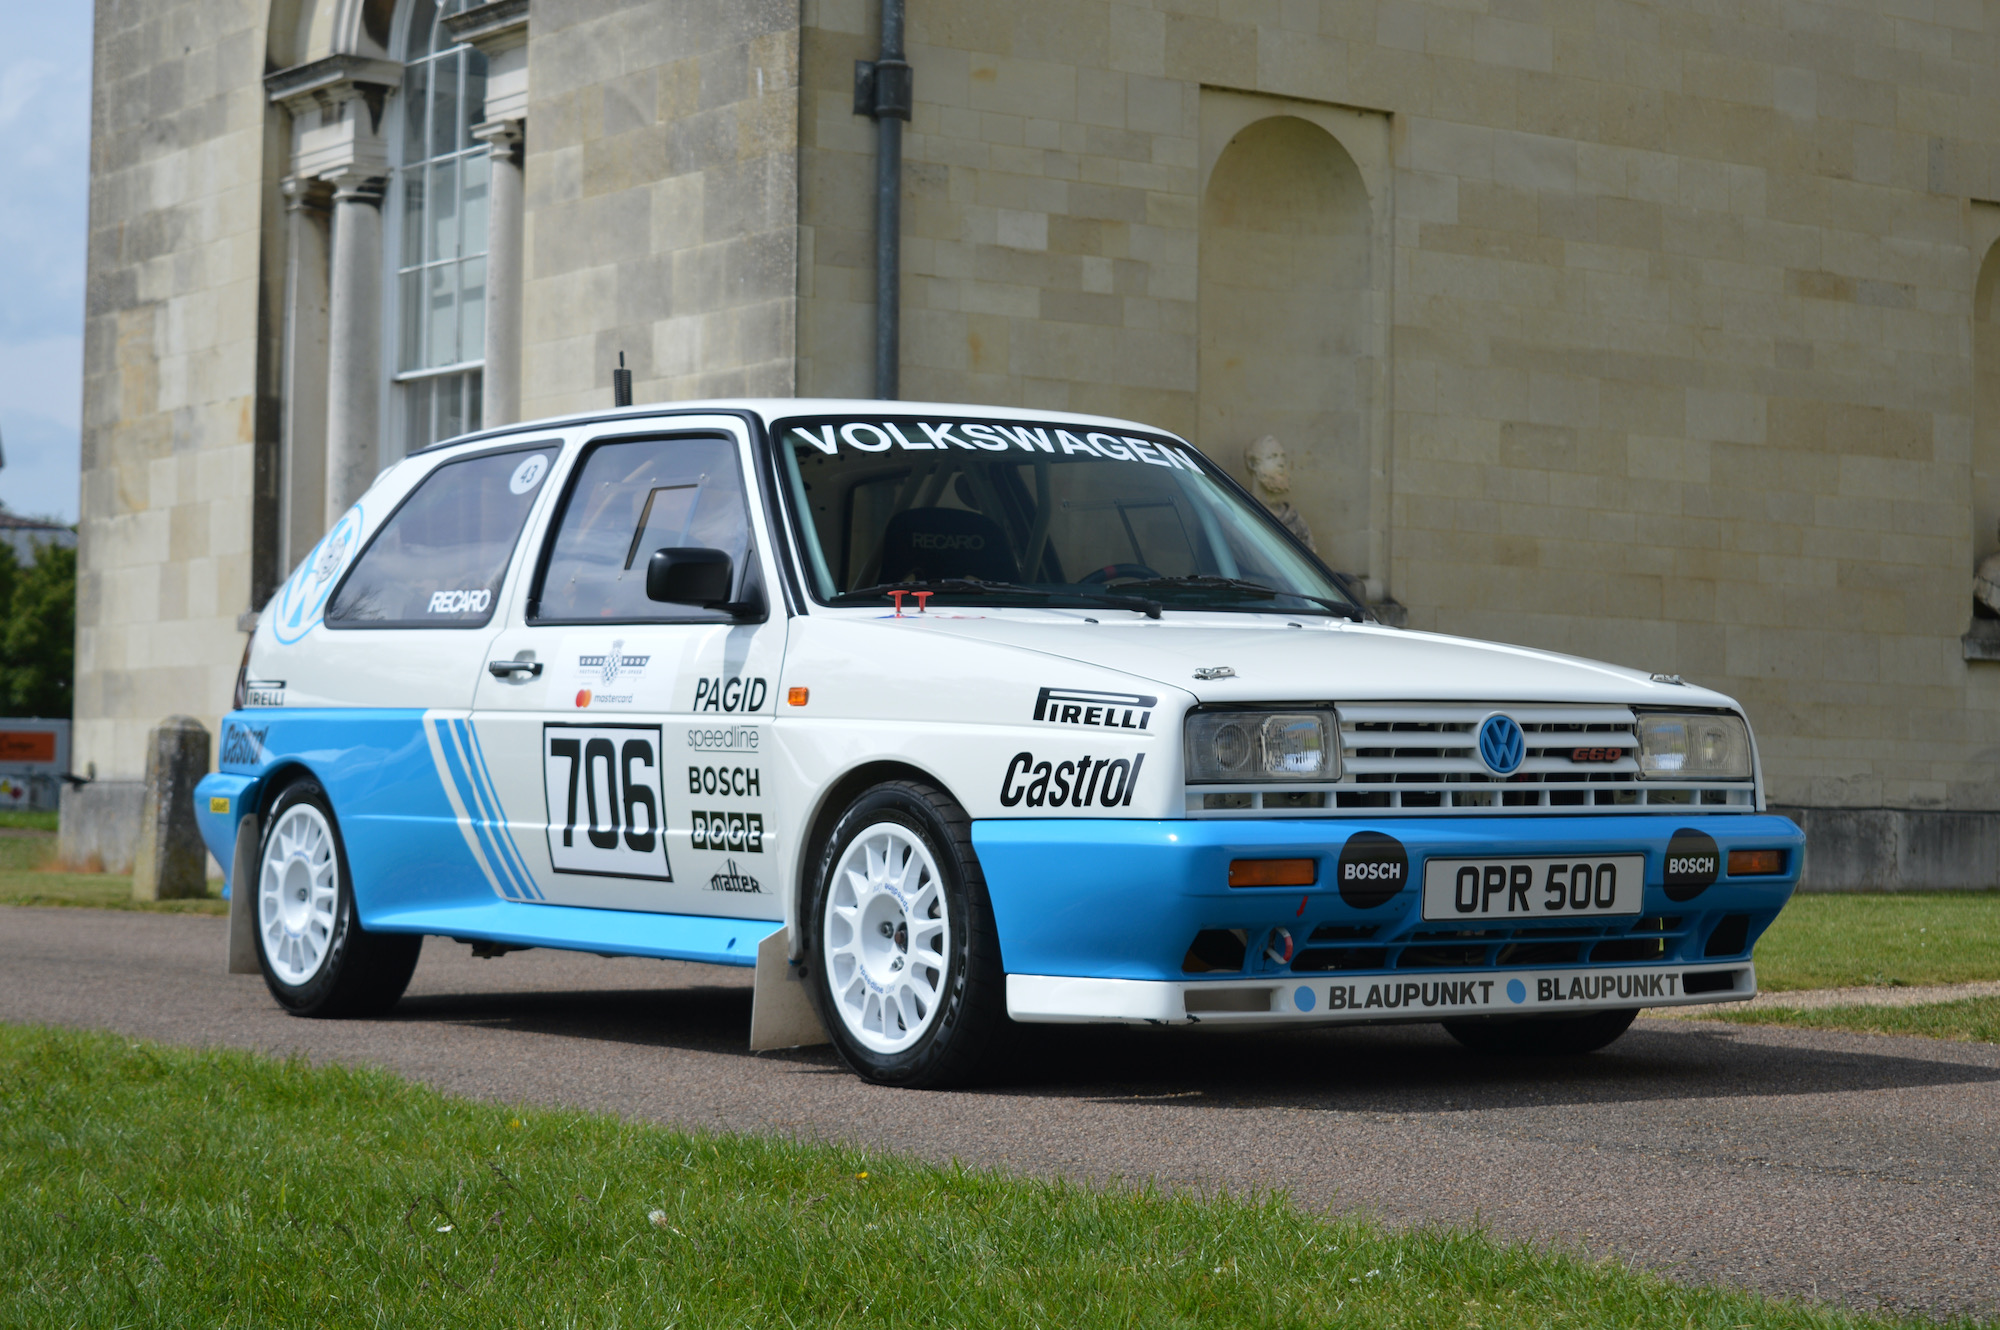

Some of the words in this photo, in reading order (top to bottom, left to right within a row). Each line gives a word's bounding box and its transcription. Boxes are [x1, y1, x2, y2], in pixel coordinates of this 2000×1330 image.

[792, 421, 1205, 475] VOLKSWAGEN
[520, 464, 539, 484] 43
[912, 533, 985, 550] RECARO
[427, 589, 491, 613] RECARO
[244, 680, 287, 706] PIRELLI
[594, 693, 634, 703] mastercard
[693, 677, 767, 712] PAGID
[1033, 687, 1158, 729] PIRELLI
[222, 723, 270, 766] Castrol
[688, 724, 760, 752] speedline
[1572, 747, 1623, 762] G60
[688, 766, 761, 797] BOSCH
[1000, 751, 1146, 808] Castrol
[550, 737, 657, 854] 706
[693, 815, 762, 847] BOGE
[1344, 863, 1400, 879] BOSCH
[1669, 857, 1715, 874] BOSCH
[1454, 862, 1533, 914] OPR
[1543, 862, 1618, 911] 500
[1328, 979, 1495, 1010] BLAUPUNKT
[1536, 973, 1680, 1002] BLAUPUNKT
